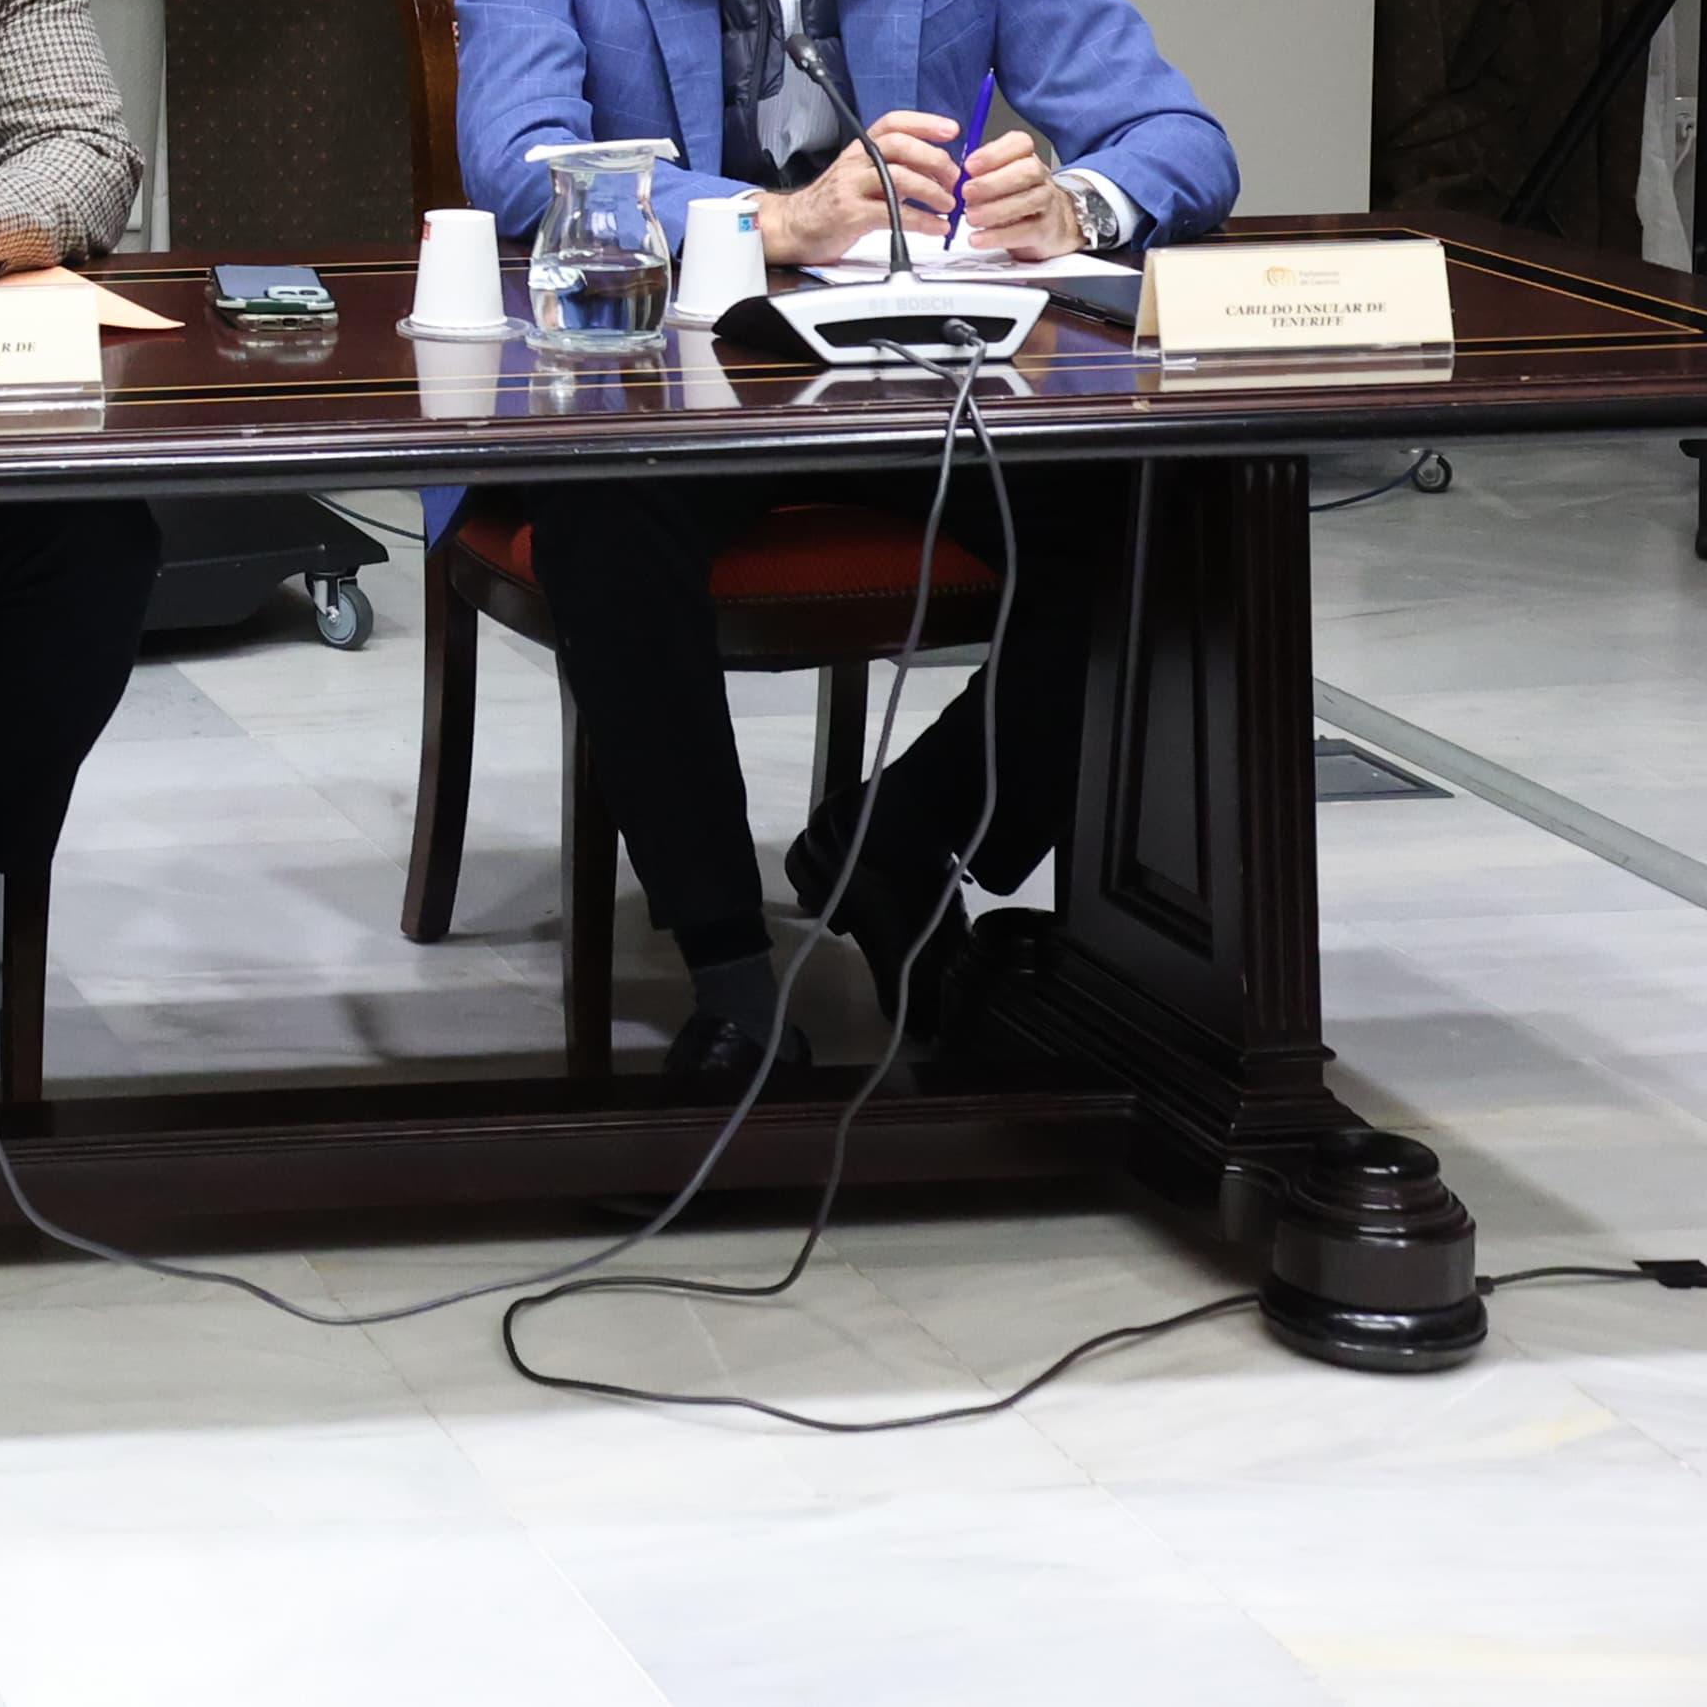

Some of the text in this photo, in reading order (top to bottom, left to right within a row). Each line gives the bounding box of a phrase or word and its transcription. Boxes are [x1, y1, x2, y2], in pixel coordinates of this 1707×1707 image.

[895, 296, 955, 311] BOSCH
[1225, 301, 1386, 316] CABILDO INSULAR DE
[1271, 315, 1344, 328] TENERIFE
[16, 341, 35, 353] DE
